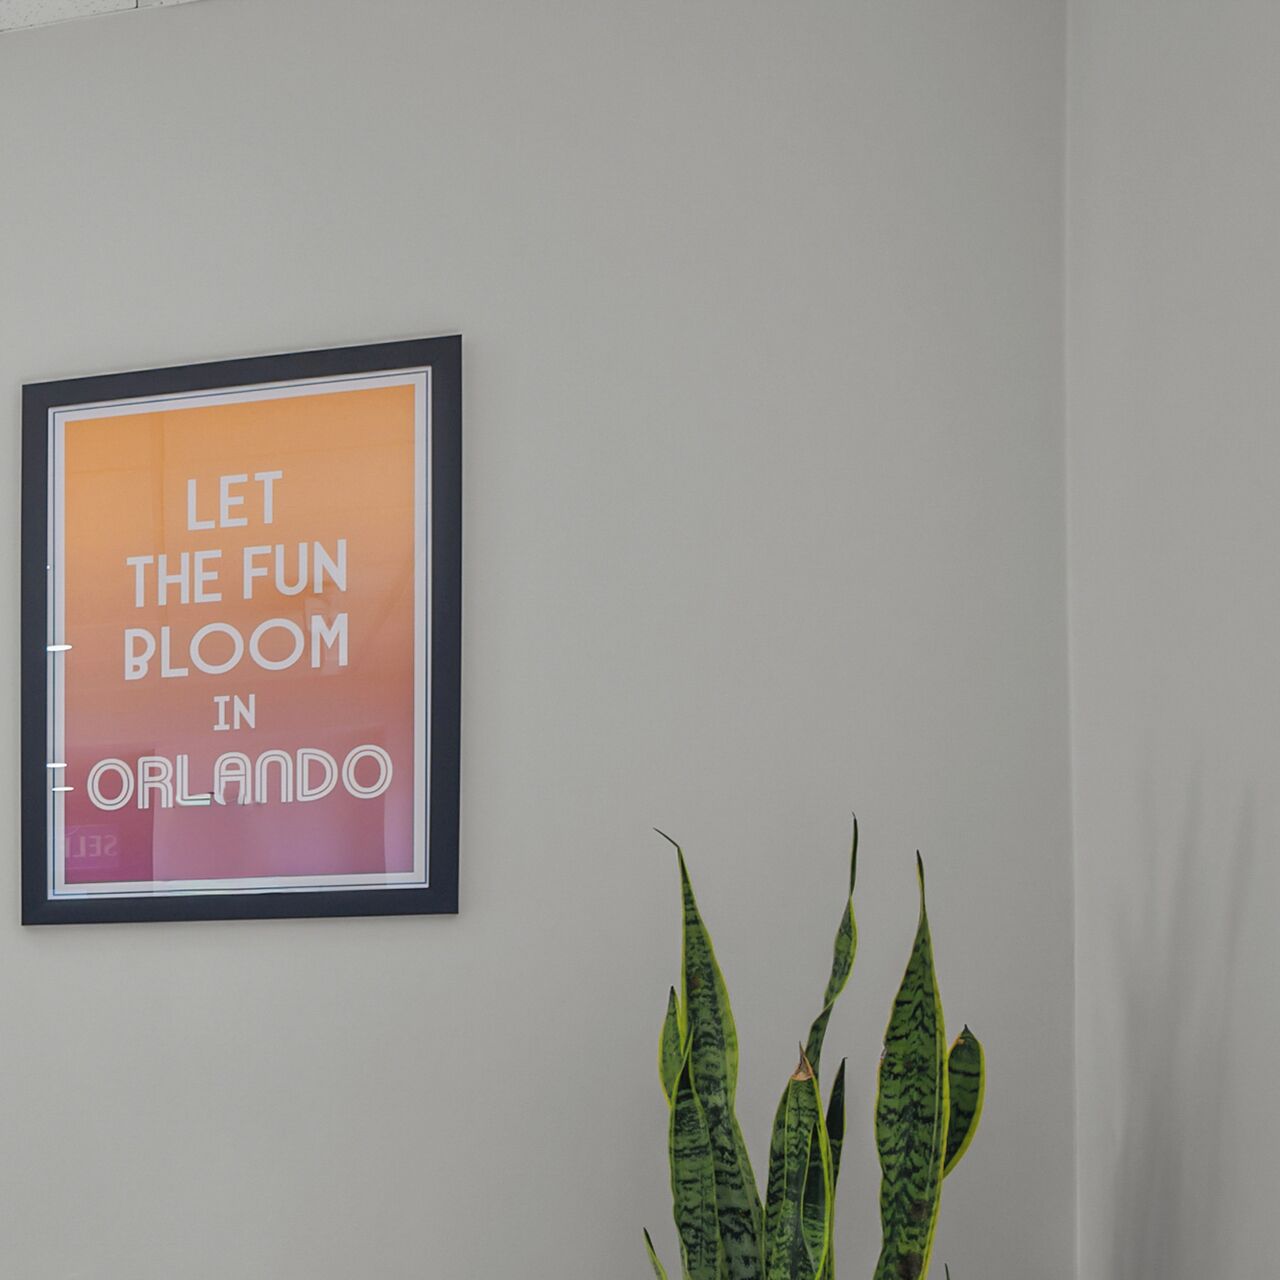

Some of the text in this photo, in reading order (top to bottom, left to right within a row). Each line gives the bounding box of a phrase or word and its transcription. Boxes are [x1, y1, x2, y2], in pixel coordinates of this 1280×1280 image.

[187, 470, 282, 531] LET
[127, 538, 347, 607] THE FUN
[124, 612, 348, 680] BLOOM
[213, 693, 256, 731] IN
[87, 744, 393, 811] ORLANDO
